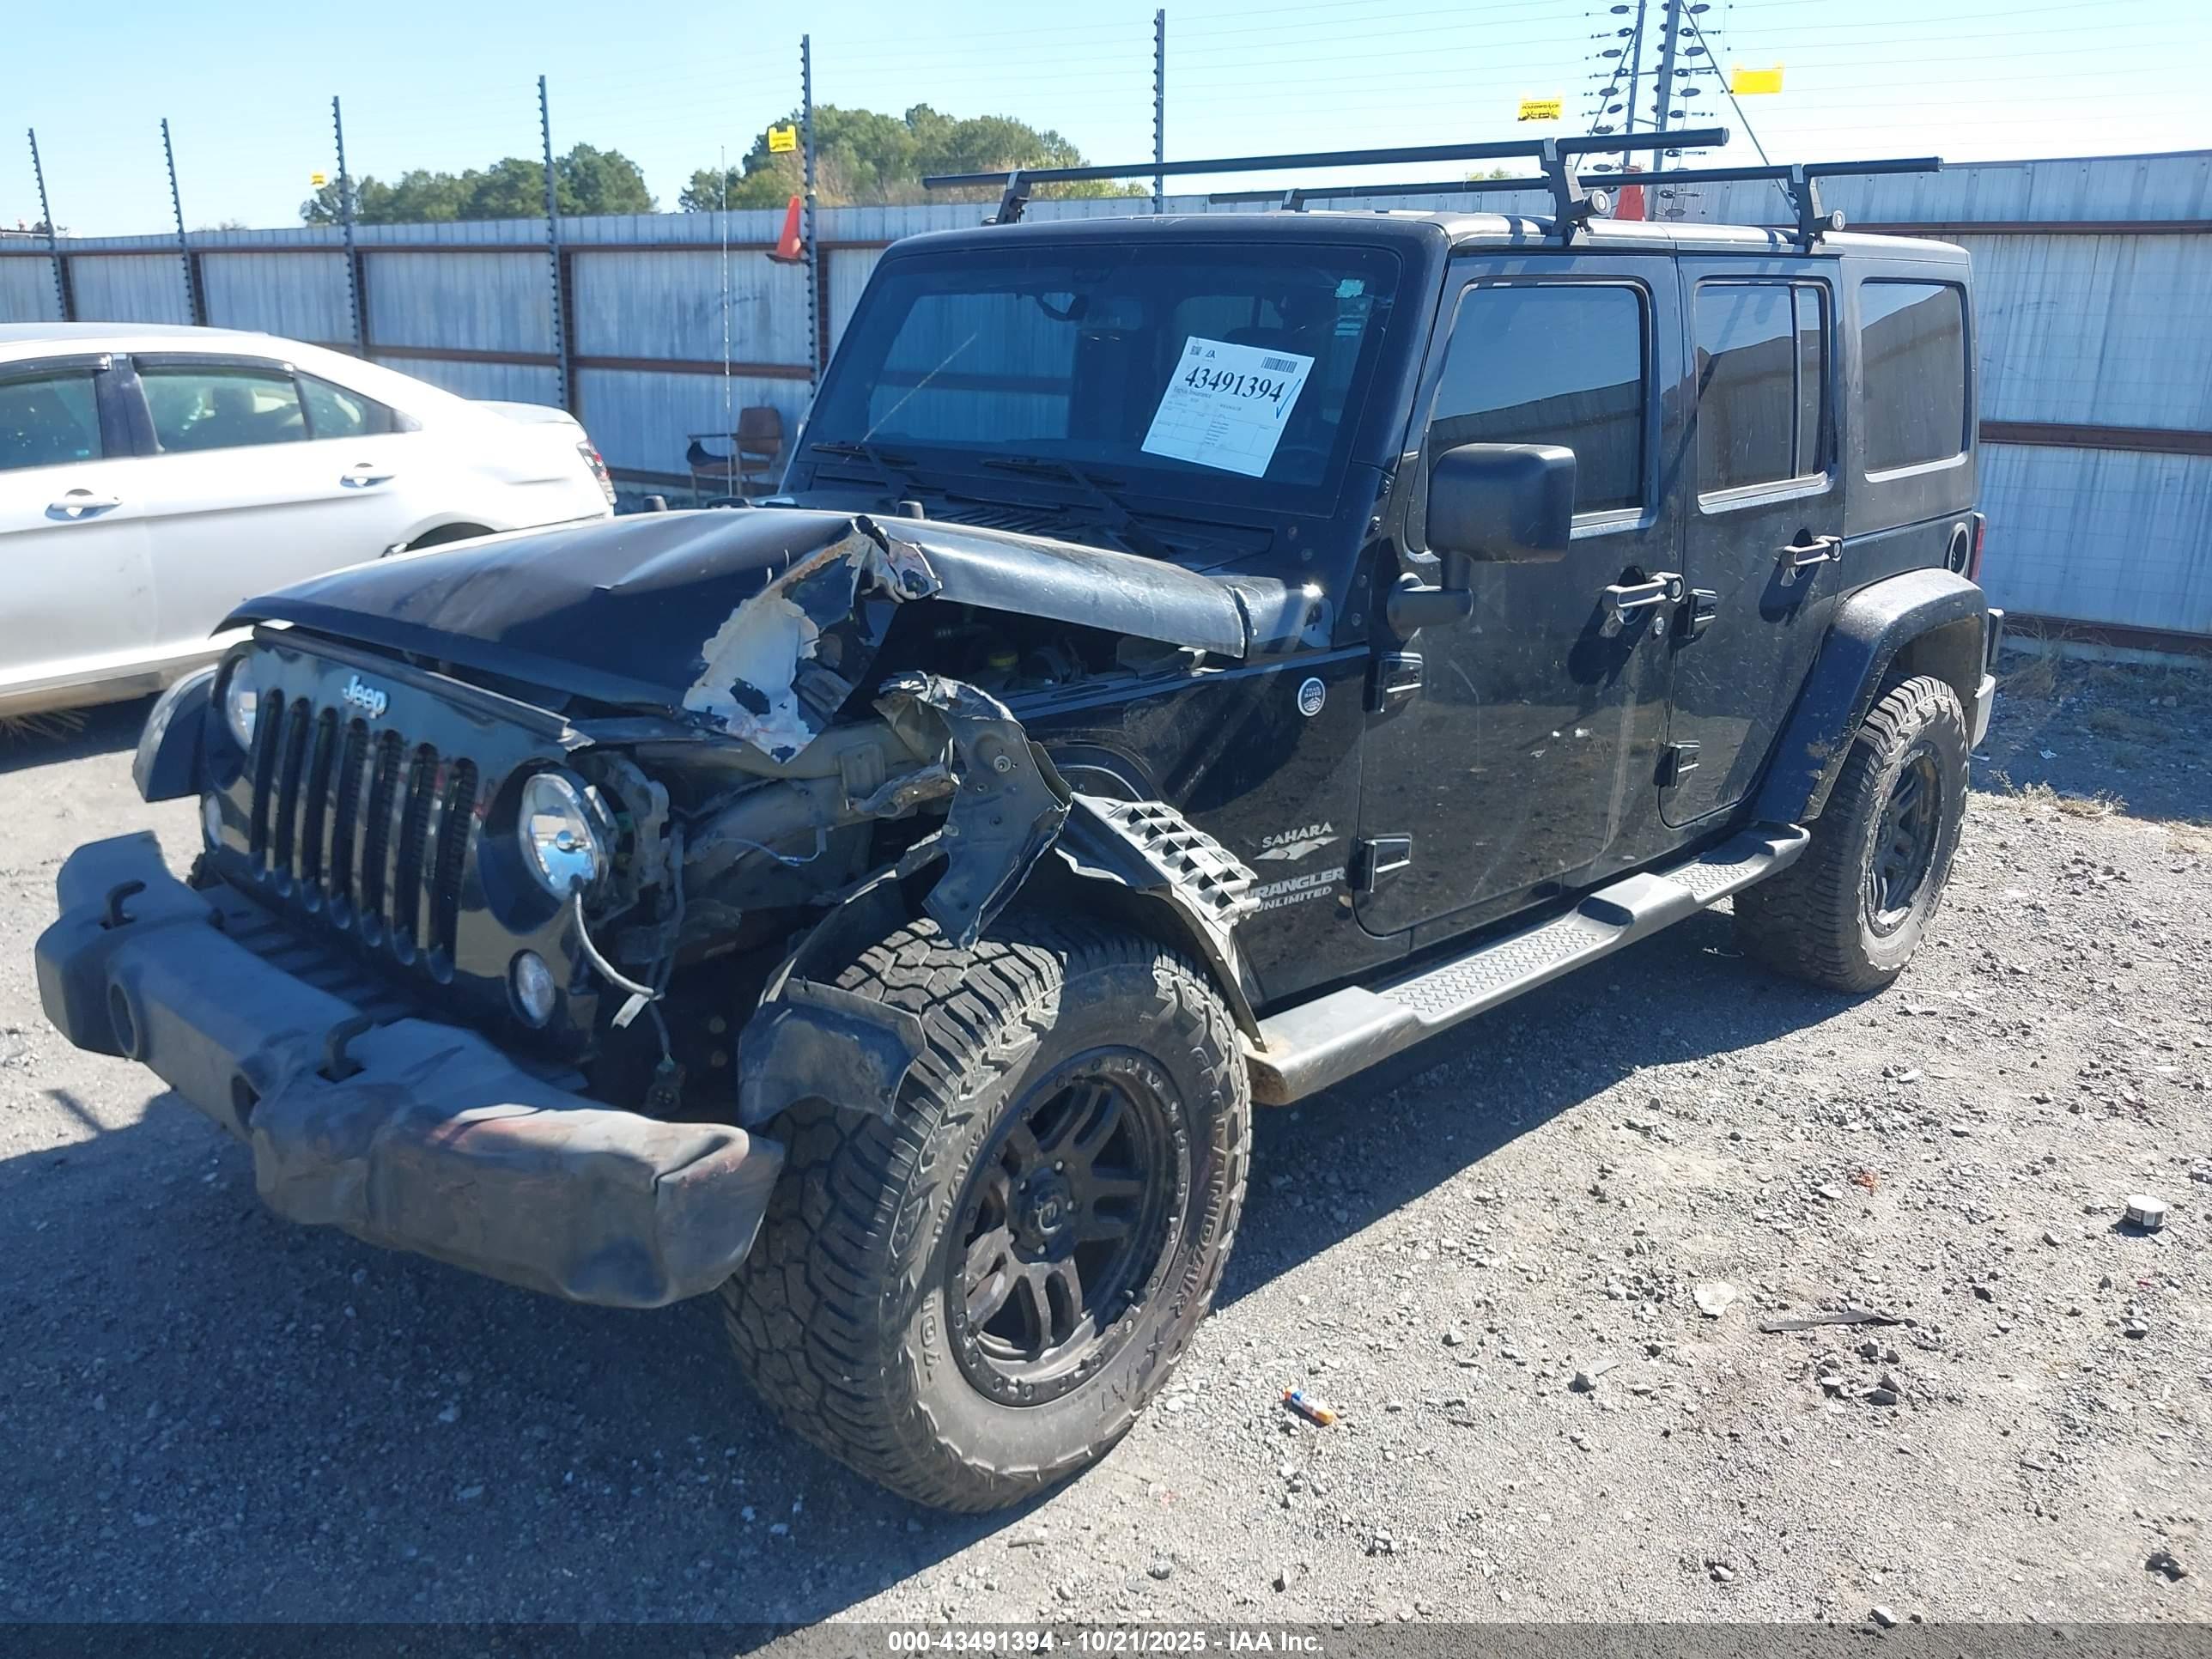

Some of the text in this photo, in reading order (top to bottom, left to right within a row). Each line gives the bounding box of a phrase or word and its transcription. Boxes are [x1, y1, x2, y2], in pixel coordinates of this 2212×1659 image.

[1184, 366, 1285, 403] 43491394
[342, 675, 386, 719] Jeep
[1262, 821, 1333, 848] SAHARA
